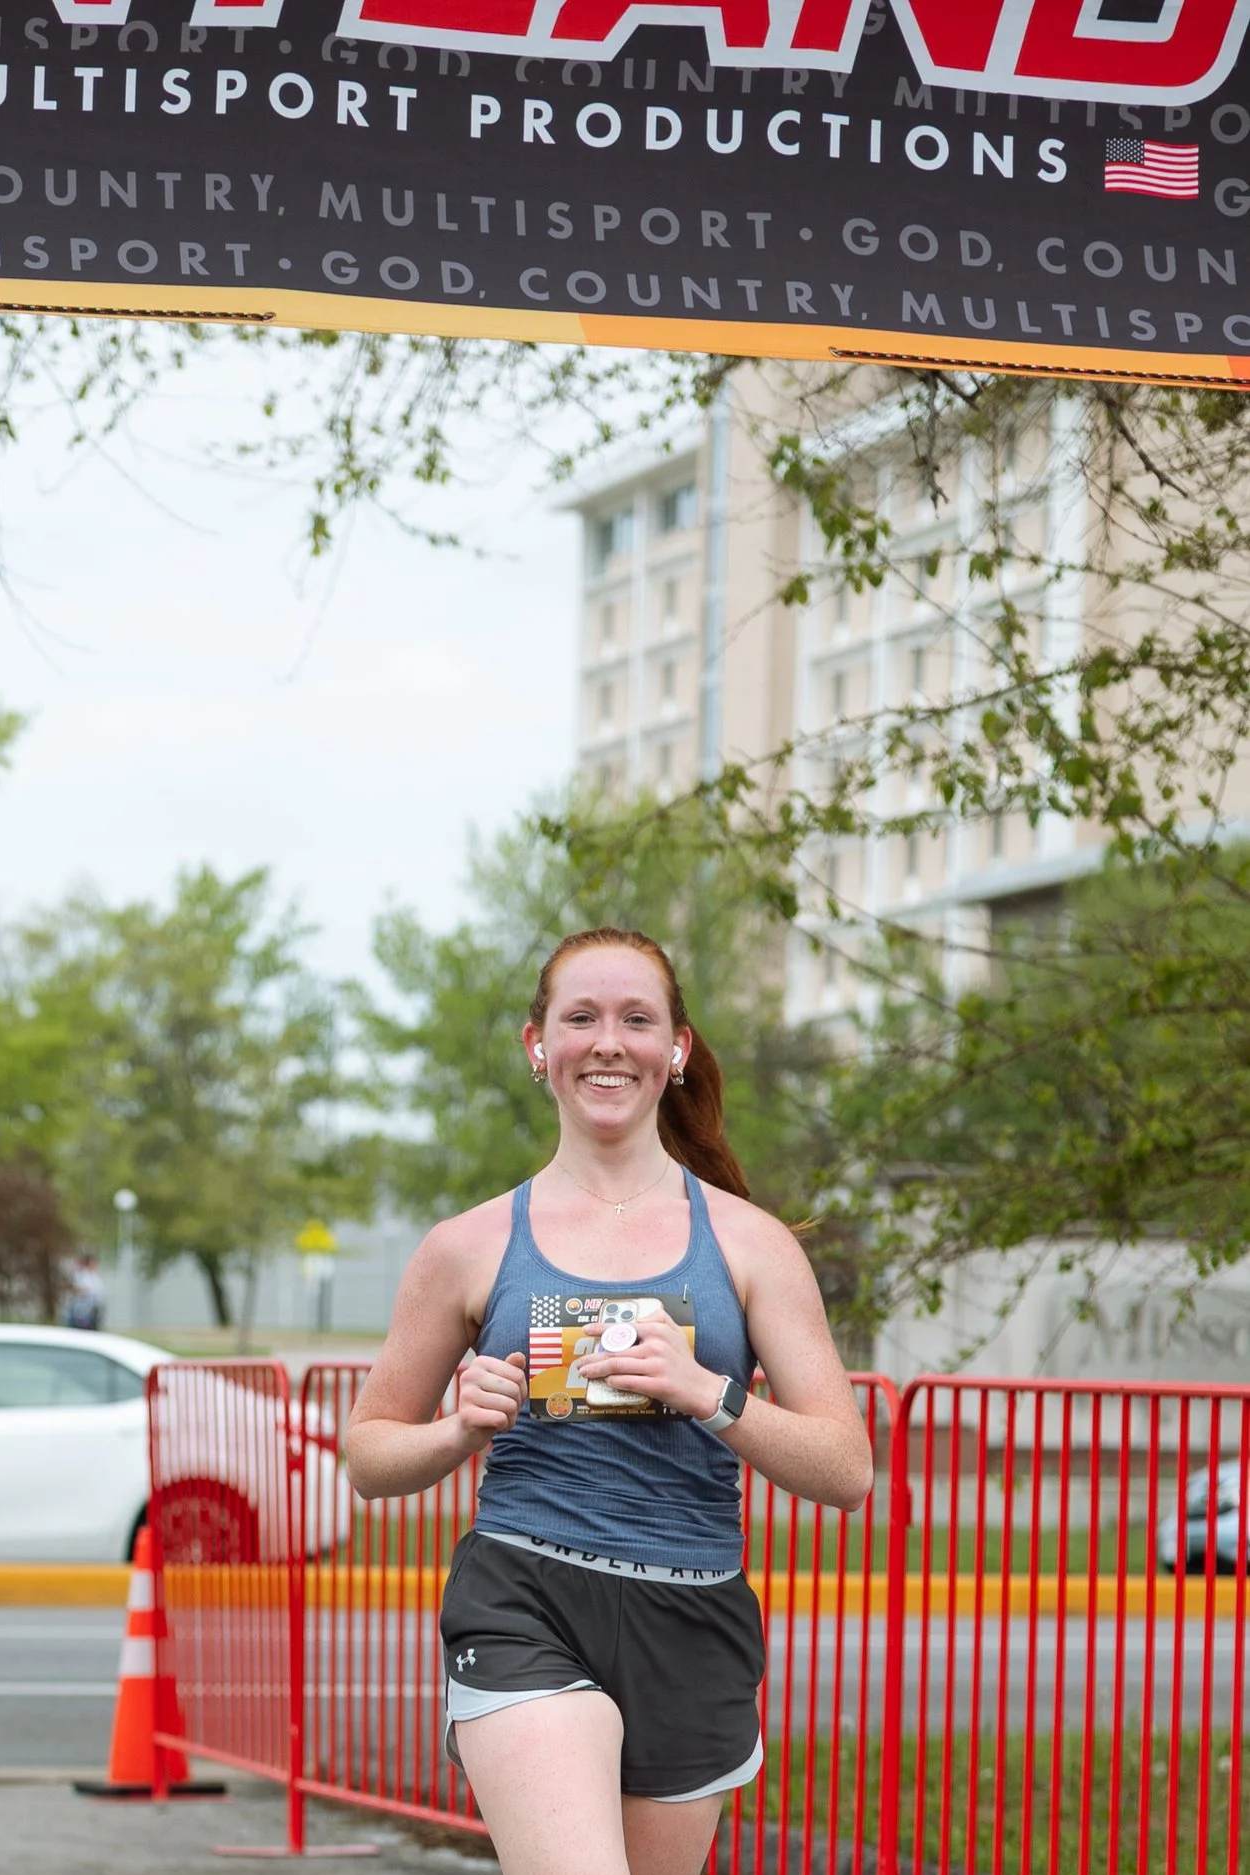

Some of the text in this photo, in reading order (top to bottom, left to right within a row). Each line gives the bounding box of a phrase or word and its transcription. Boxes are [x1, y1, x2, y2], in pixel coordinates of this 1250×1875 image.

[469, 93, 1068, 184] PRODUCTIONS
[318, 181, 772, 249] MULTISPORT
[841, 217, 1005, 273] GOD,
[1036, 237, 1238, 286] COUN
[321, 250, 486, 300] GOD,
[518, 267, 869, 321] COUNTRY,
[900, 290, 1250, 346] MULTISPO
